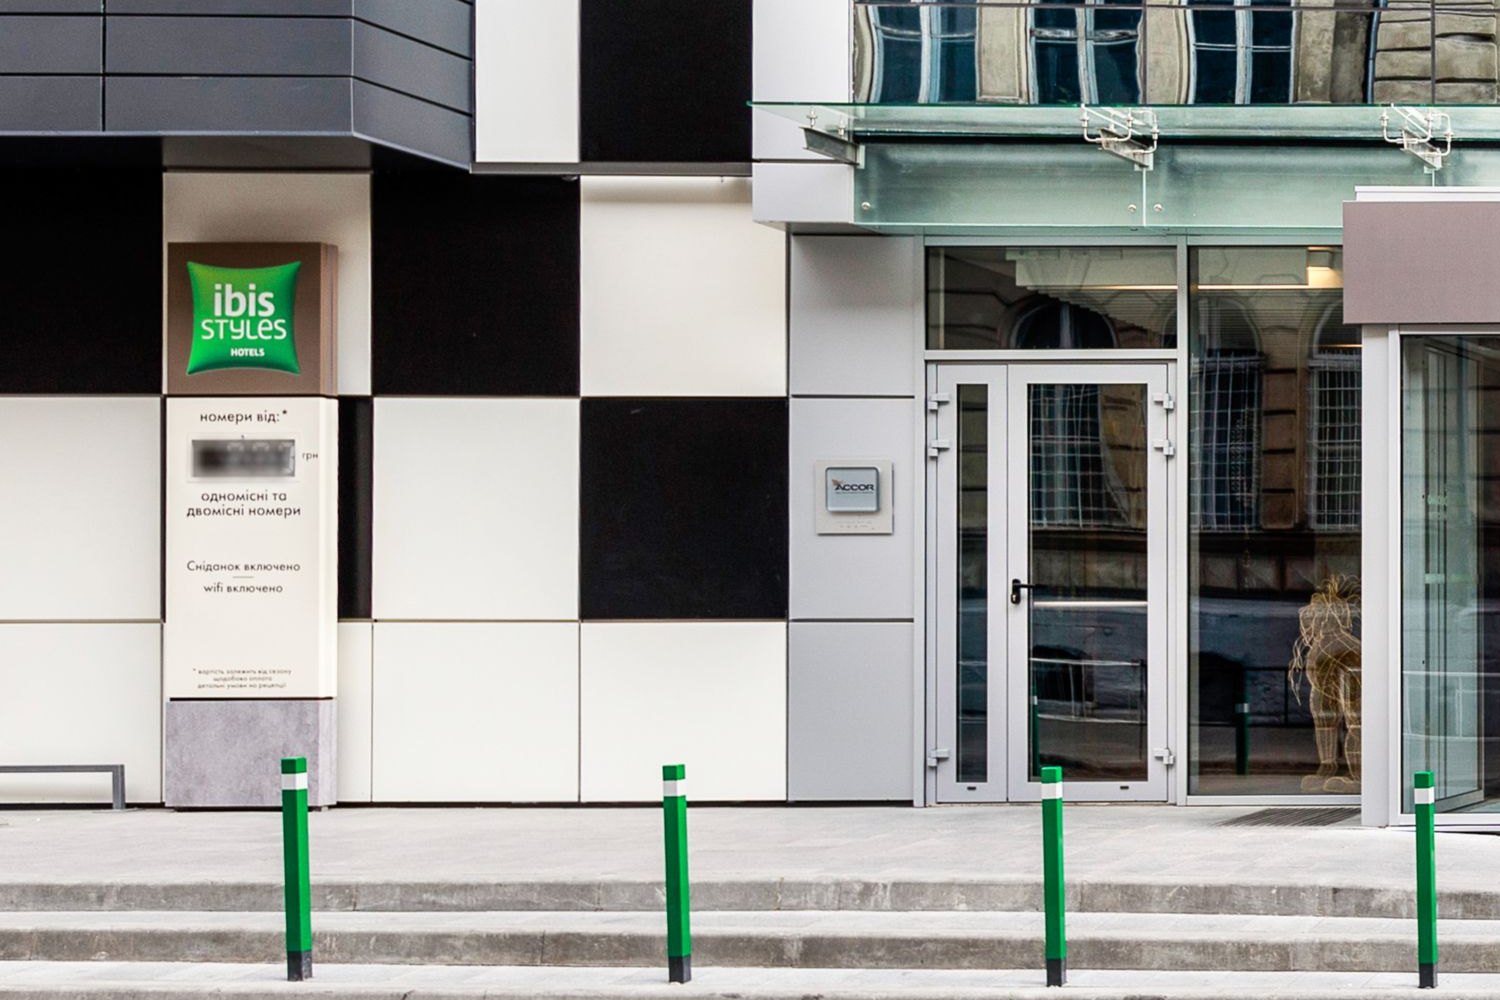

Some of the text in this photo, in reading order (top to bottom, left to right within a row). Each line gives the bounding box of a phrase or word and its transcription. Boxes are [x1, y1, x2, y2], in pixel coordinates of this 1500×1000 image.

[213, 283, 276, 317] ibis
[230, 347, 266, 357] HOTELS
[200, 412, 252, 425] номери
[301, 452, 319, 462] грн
[201, 489, 287, 503] одномісні та
[186, 503, 301, 519] двомісні номери
[186, 560, 301, 573] Сніданок включено
[203, 582, 284, 593] wifi включено
